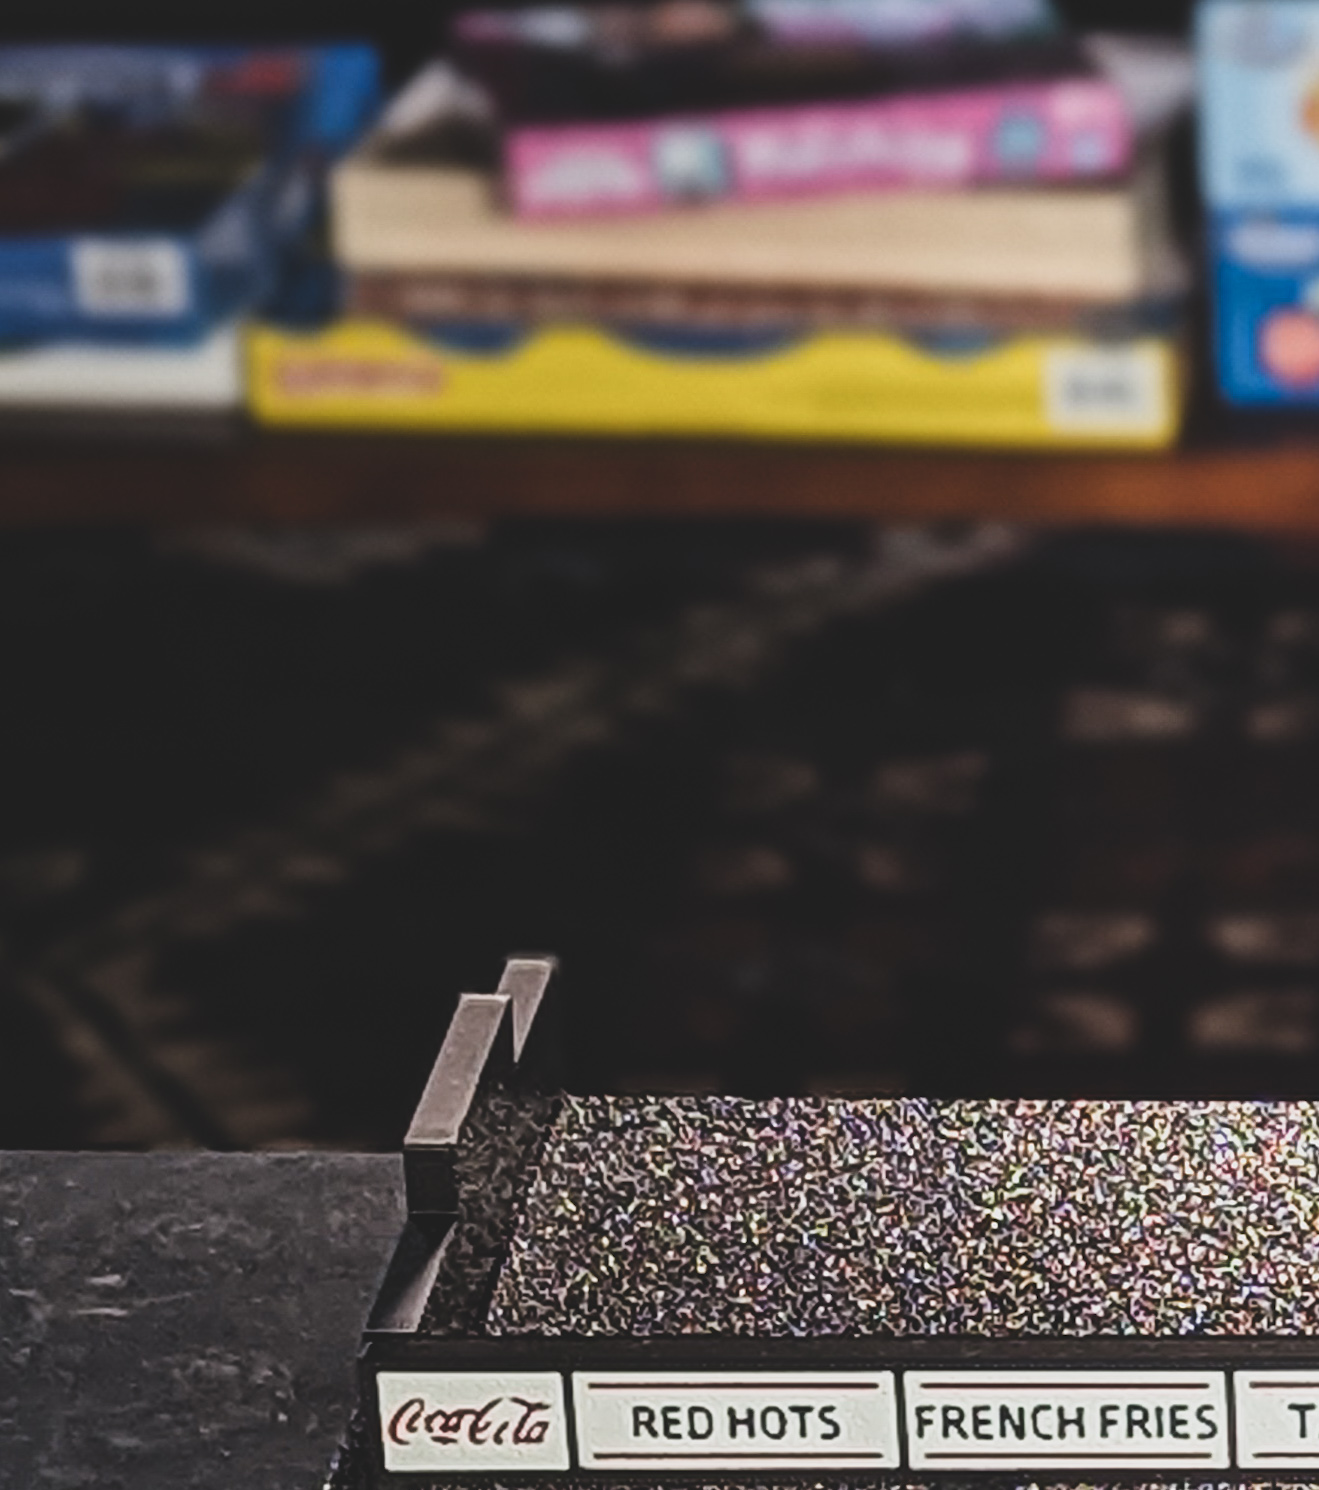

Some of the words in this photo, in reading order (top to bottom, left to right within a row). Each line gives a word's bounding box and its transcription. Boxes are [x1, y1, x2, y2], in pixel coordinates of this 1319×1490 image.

[633, 1406, 713, 1439] RED
[727, 1406, 840, 1440] HOTS
[915, 1405, 1085, 1440] FRENCH
[1100, 1404, 1217, 1439] FRIES
